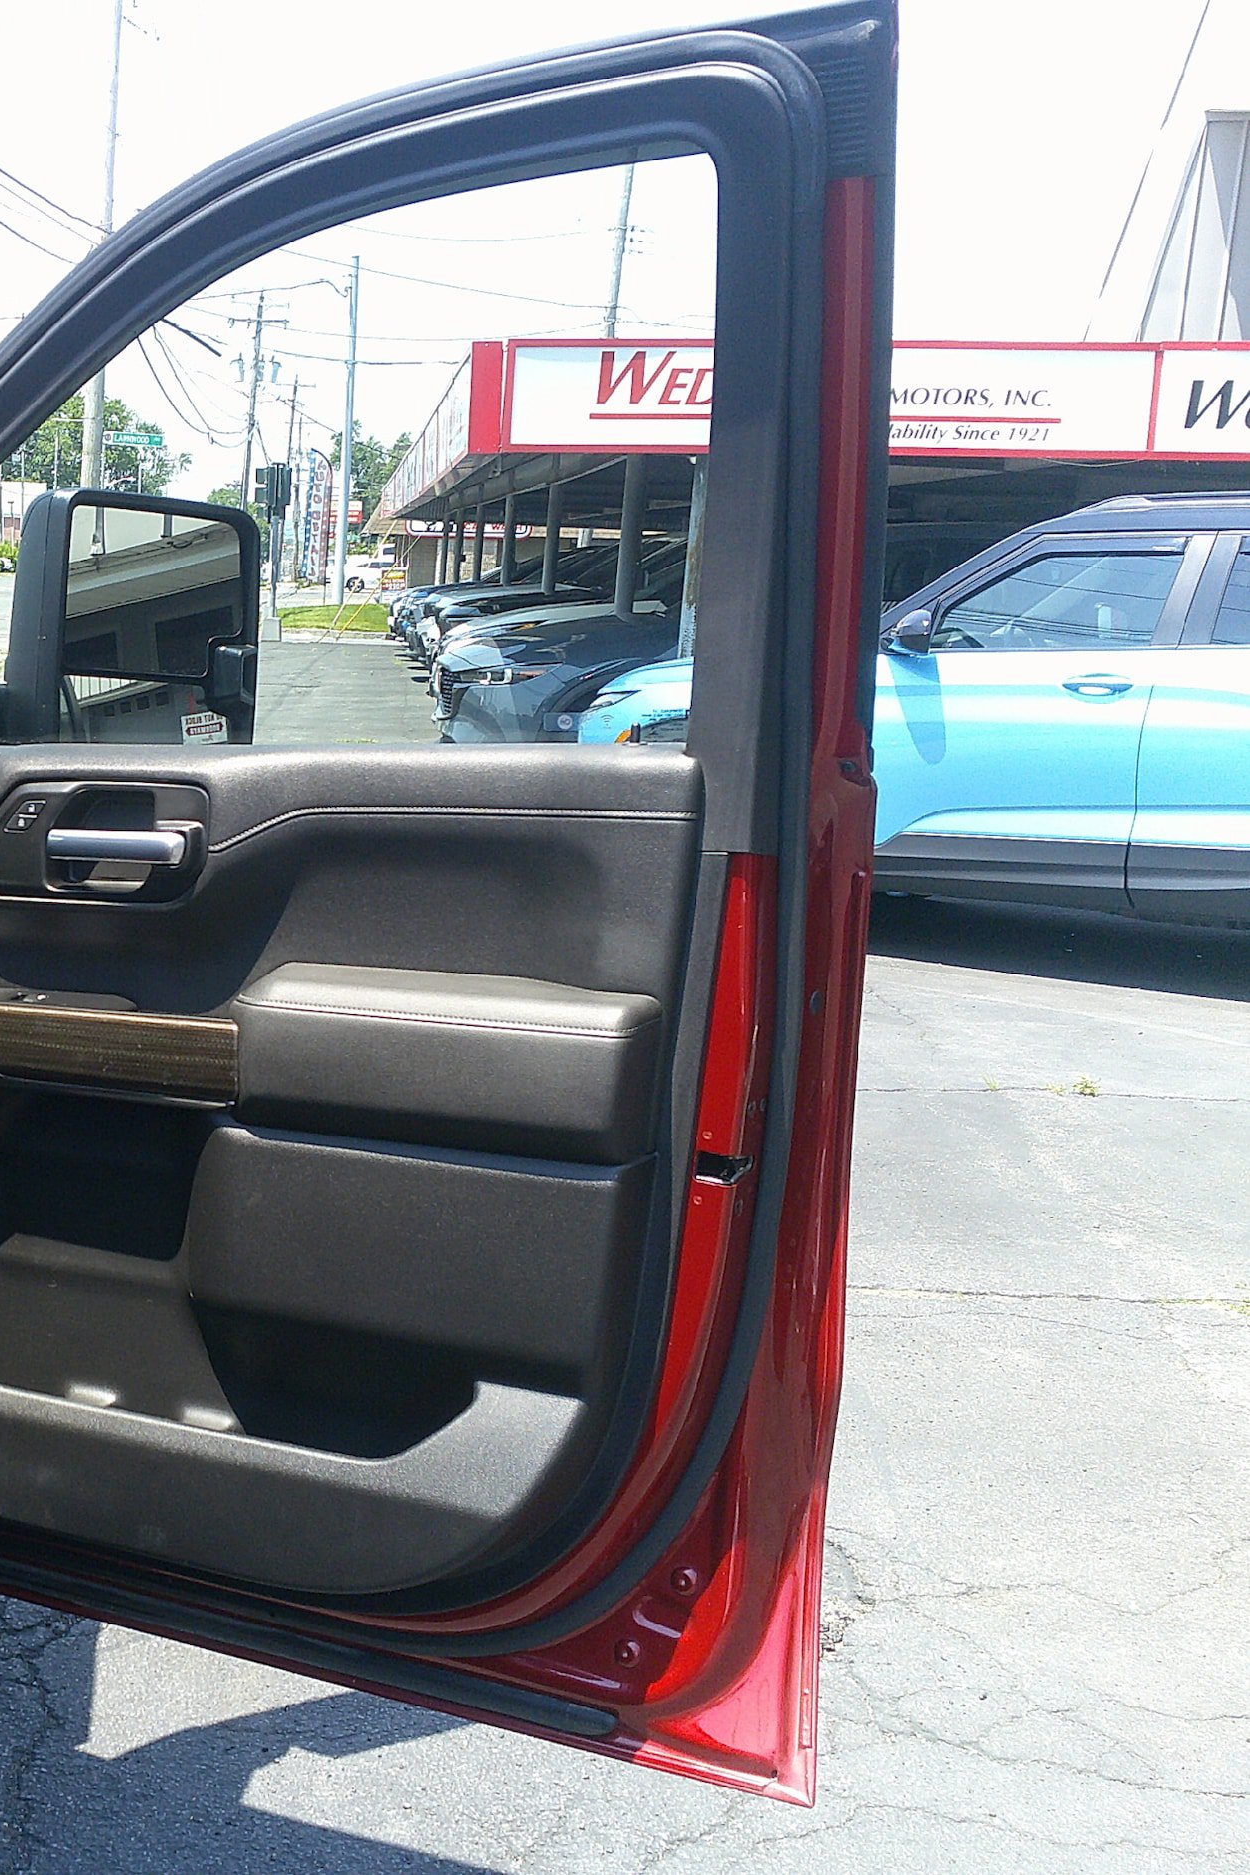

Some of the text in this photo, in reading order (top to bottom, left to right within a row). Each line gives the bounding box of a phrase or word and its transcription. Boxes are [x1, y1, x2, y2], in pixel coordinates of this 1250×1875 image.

[889, 387, 1052, 408] MOTORS, INC.
[1184, 379, 1250, 430] W
[952, 424, 1000, 441] Since
[1008, 427, 1050, 441] 1921
